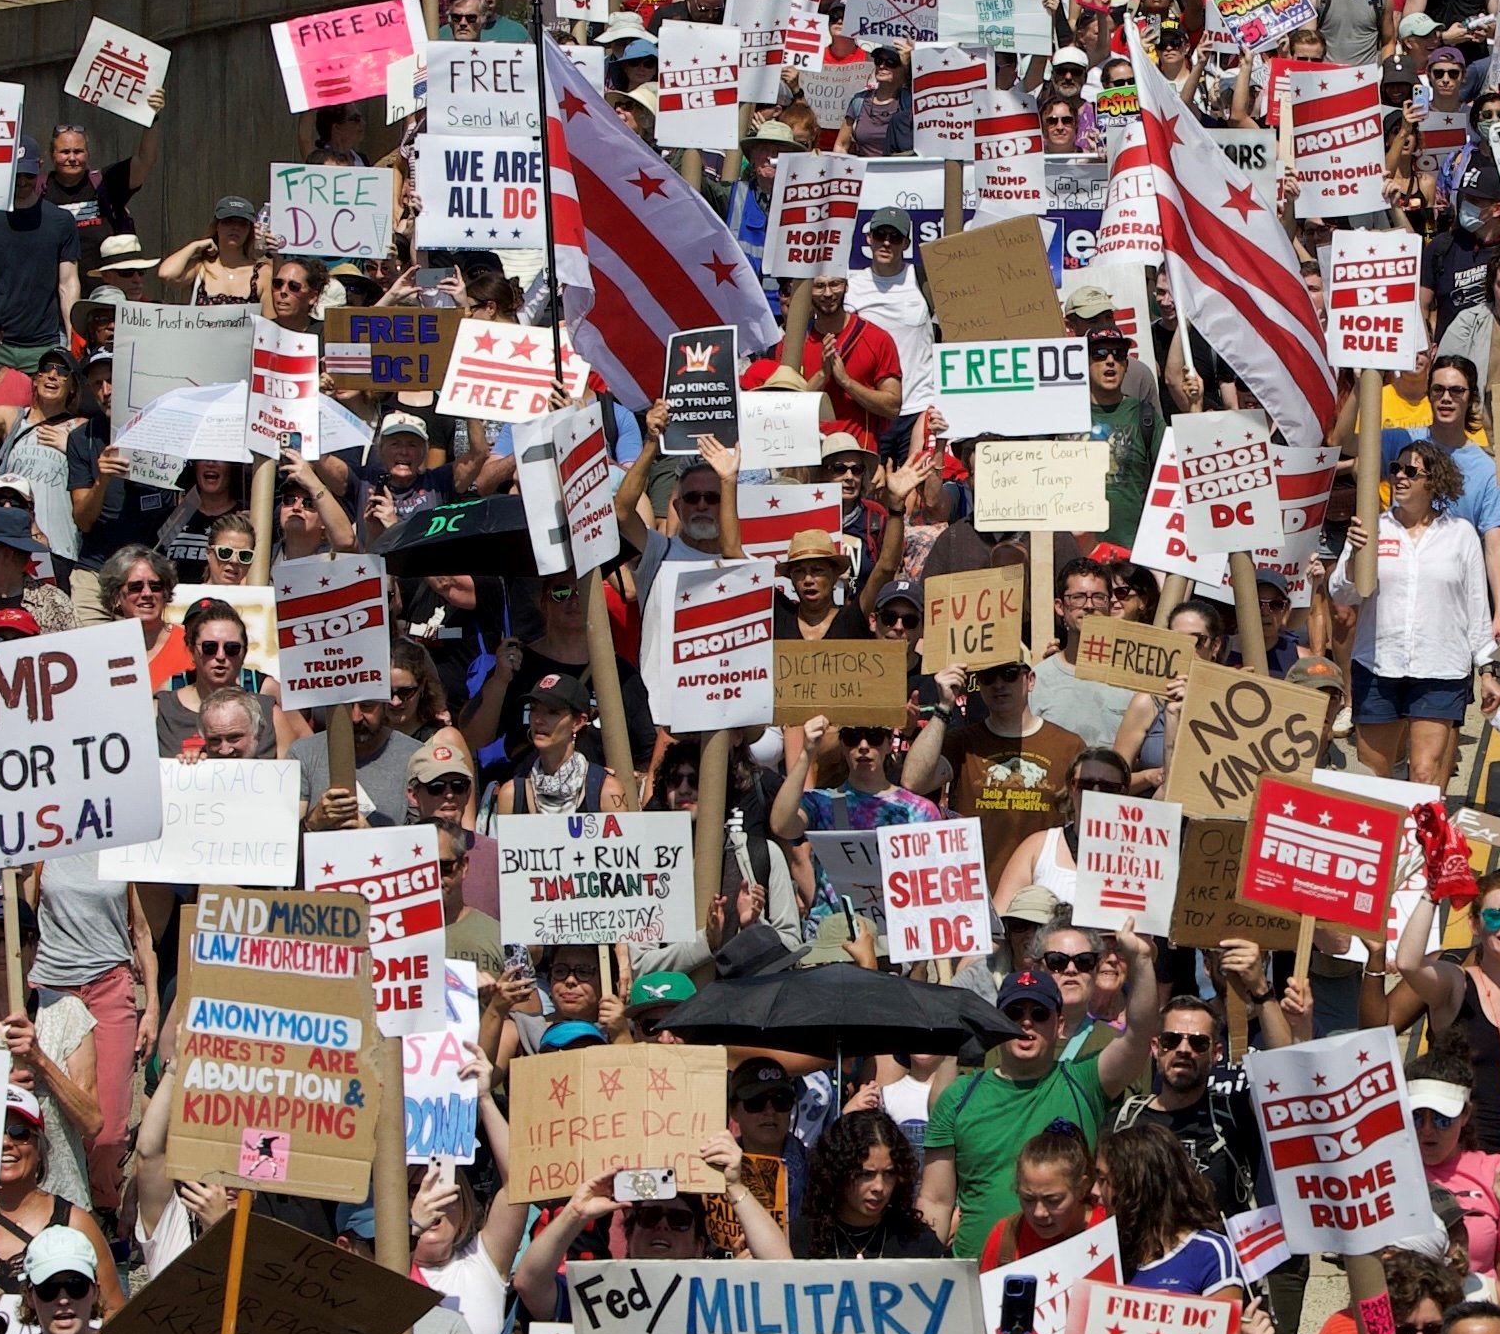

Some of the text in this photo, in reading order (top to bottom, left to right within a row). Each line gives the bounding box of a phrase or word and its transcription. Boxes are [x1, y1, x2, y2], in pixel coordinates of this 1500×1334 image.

[446, 150, 540, 181] WE ARE
[448, 187, 538, 219] ALL DC
[984, 443, 1092, 466] Supreme Court
[992, 470, 1073, 489] Gave Trump
[975, 496, 1095, 519] Authoritarian Powers
[1189, 679, 1272, 758] NO
[73, 733, 131, 778] TO
[1200, 714, 1321, 809] KINGS
[569, 814, 622, 838] USA
[1118, 805, 1144, 821] NO
[889, 828, 969, 859] STOP THE
[1086, 817, 1170, 846] HUMAN
[502, 844, 684, 872] BUILT RUN BY
[1086, 853, 1166, 879] ILLEGAL
[530, 872, 670, 901] IMMIGRANTS
[889, 859, 982, 908] SIEGE
[548, 908, 656, 933] #HERE2STAY
[905, 929, 920, 949] IN
